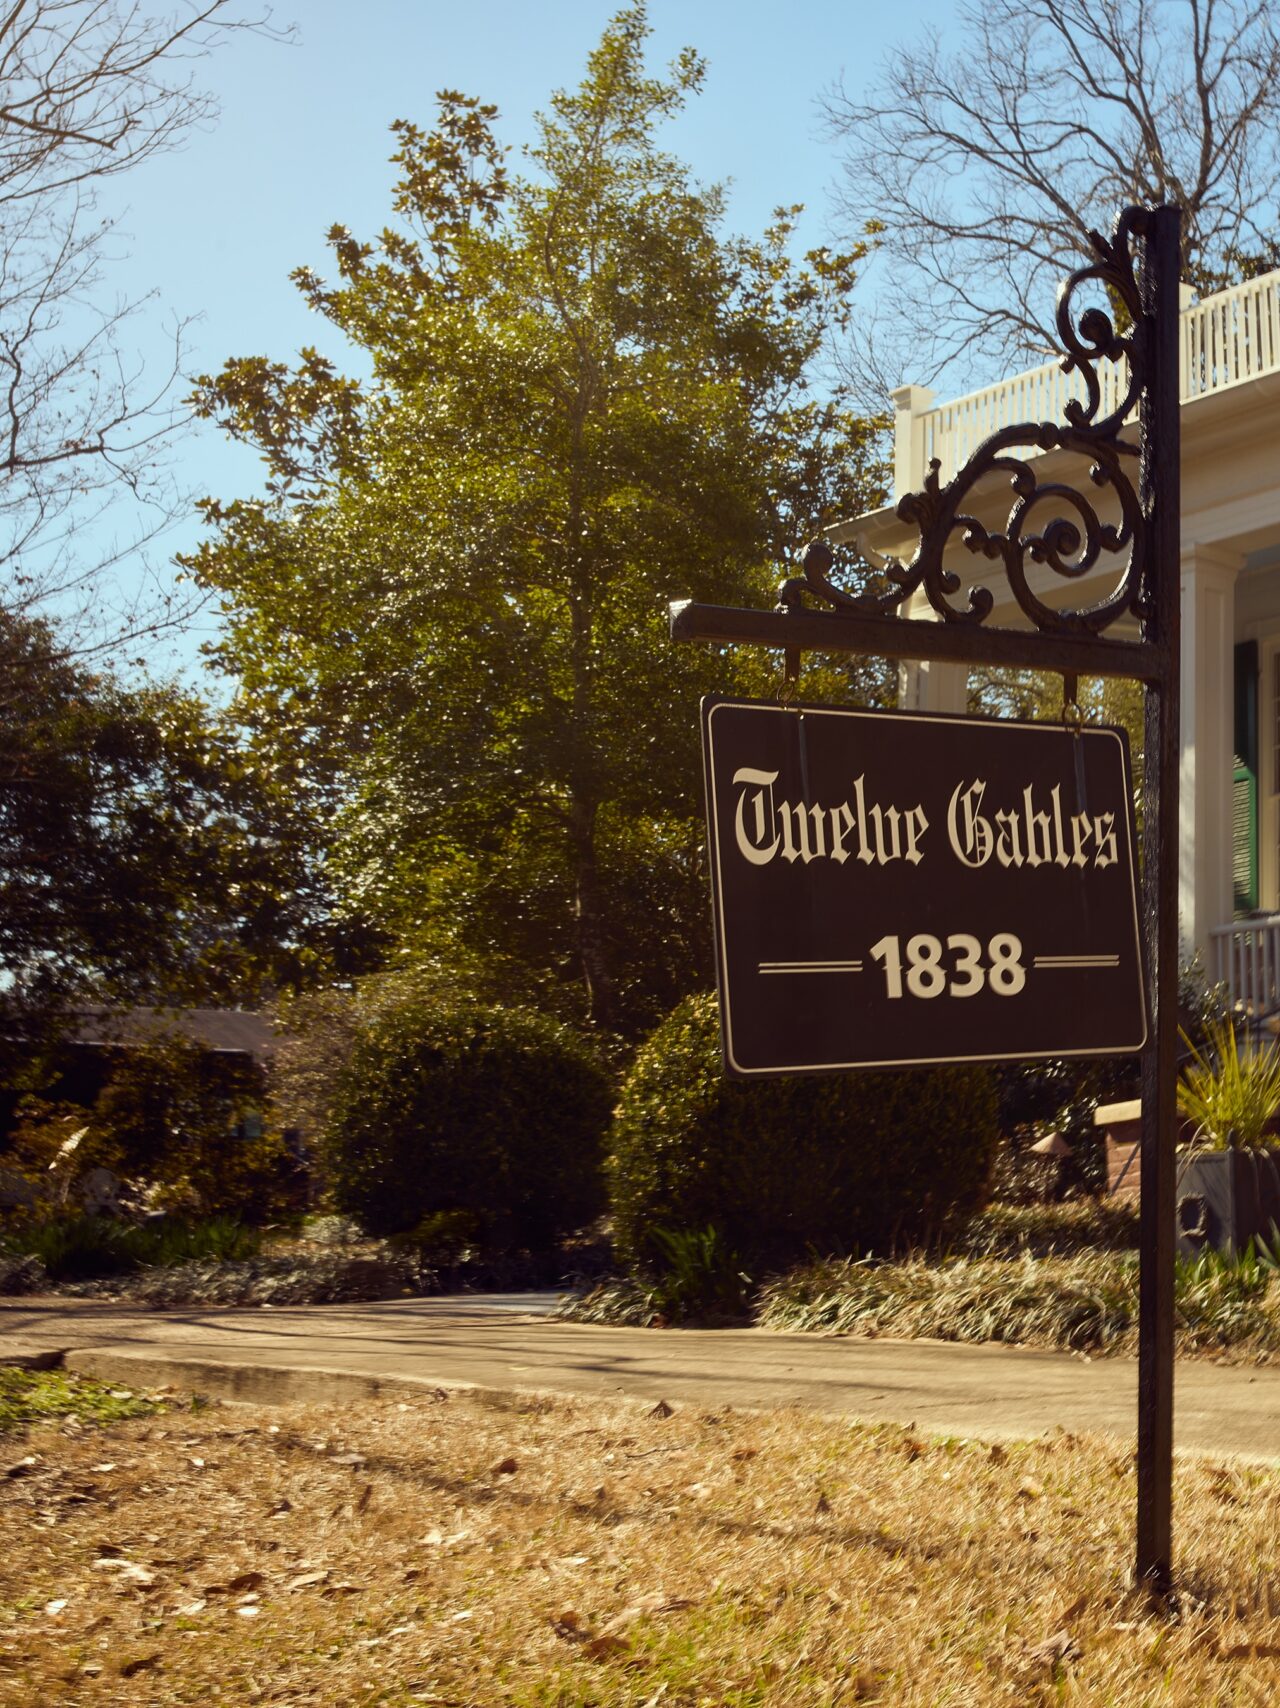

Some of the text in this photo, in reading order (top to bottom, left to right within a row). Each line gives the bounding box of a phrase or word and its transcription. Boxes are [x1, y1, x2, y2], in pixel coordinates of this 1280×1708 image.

[732, 767, 1119, 869] Twelve Gables
[869, 933, 1026, 999] 1838
